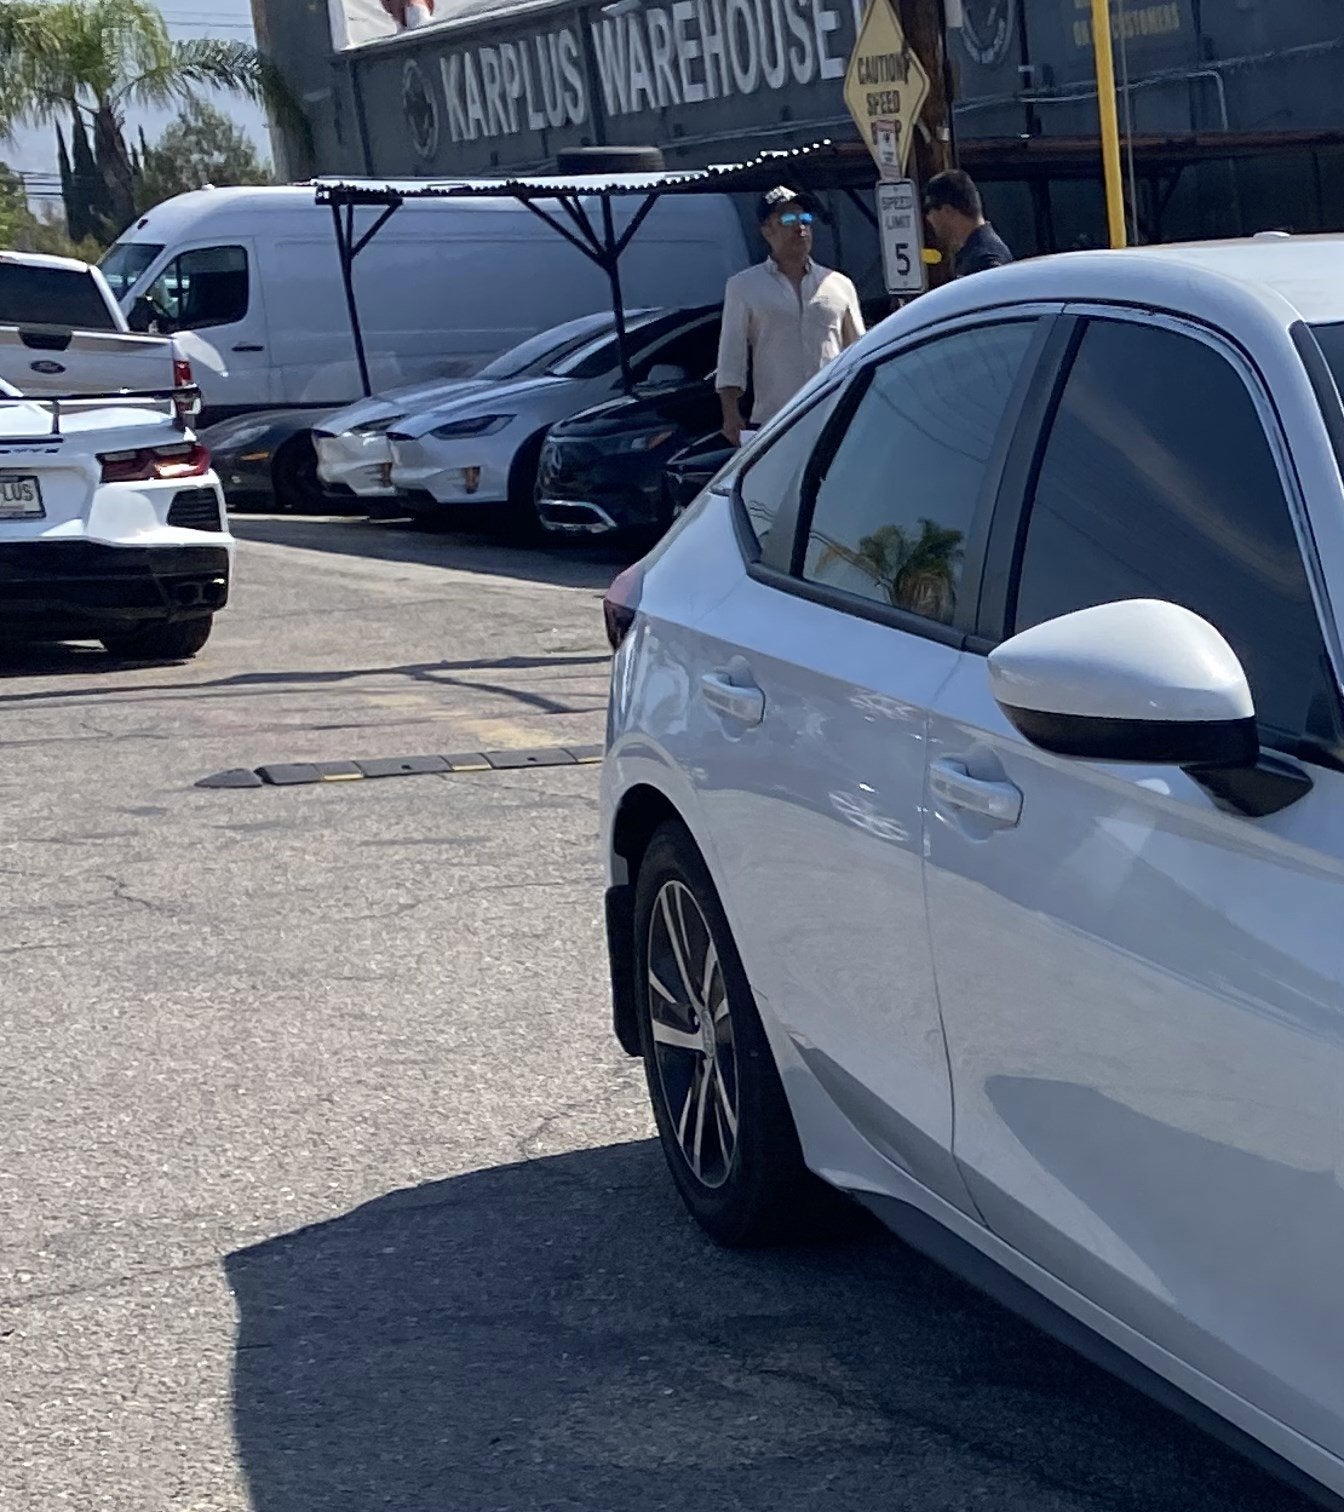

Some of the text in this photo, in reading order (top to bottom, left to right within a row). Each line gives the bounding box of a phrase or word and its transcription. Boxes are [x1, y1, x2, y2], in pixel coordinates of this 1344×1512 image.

[440, 28, 585, 142] KARPLUS
[592, 0, 845, 117] WAREHOUSE
[858, 53, 908, 85] CAUTION
[866, 90, 900, 116] SPEED
[881, 195, 912, 211] SPEED
[895, 243, 911, 276] 5
